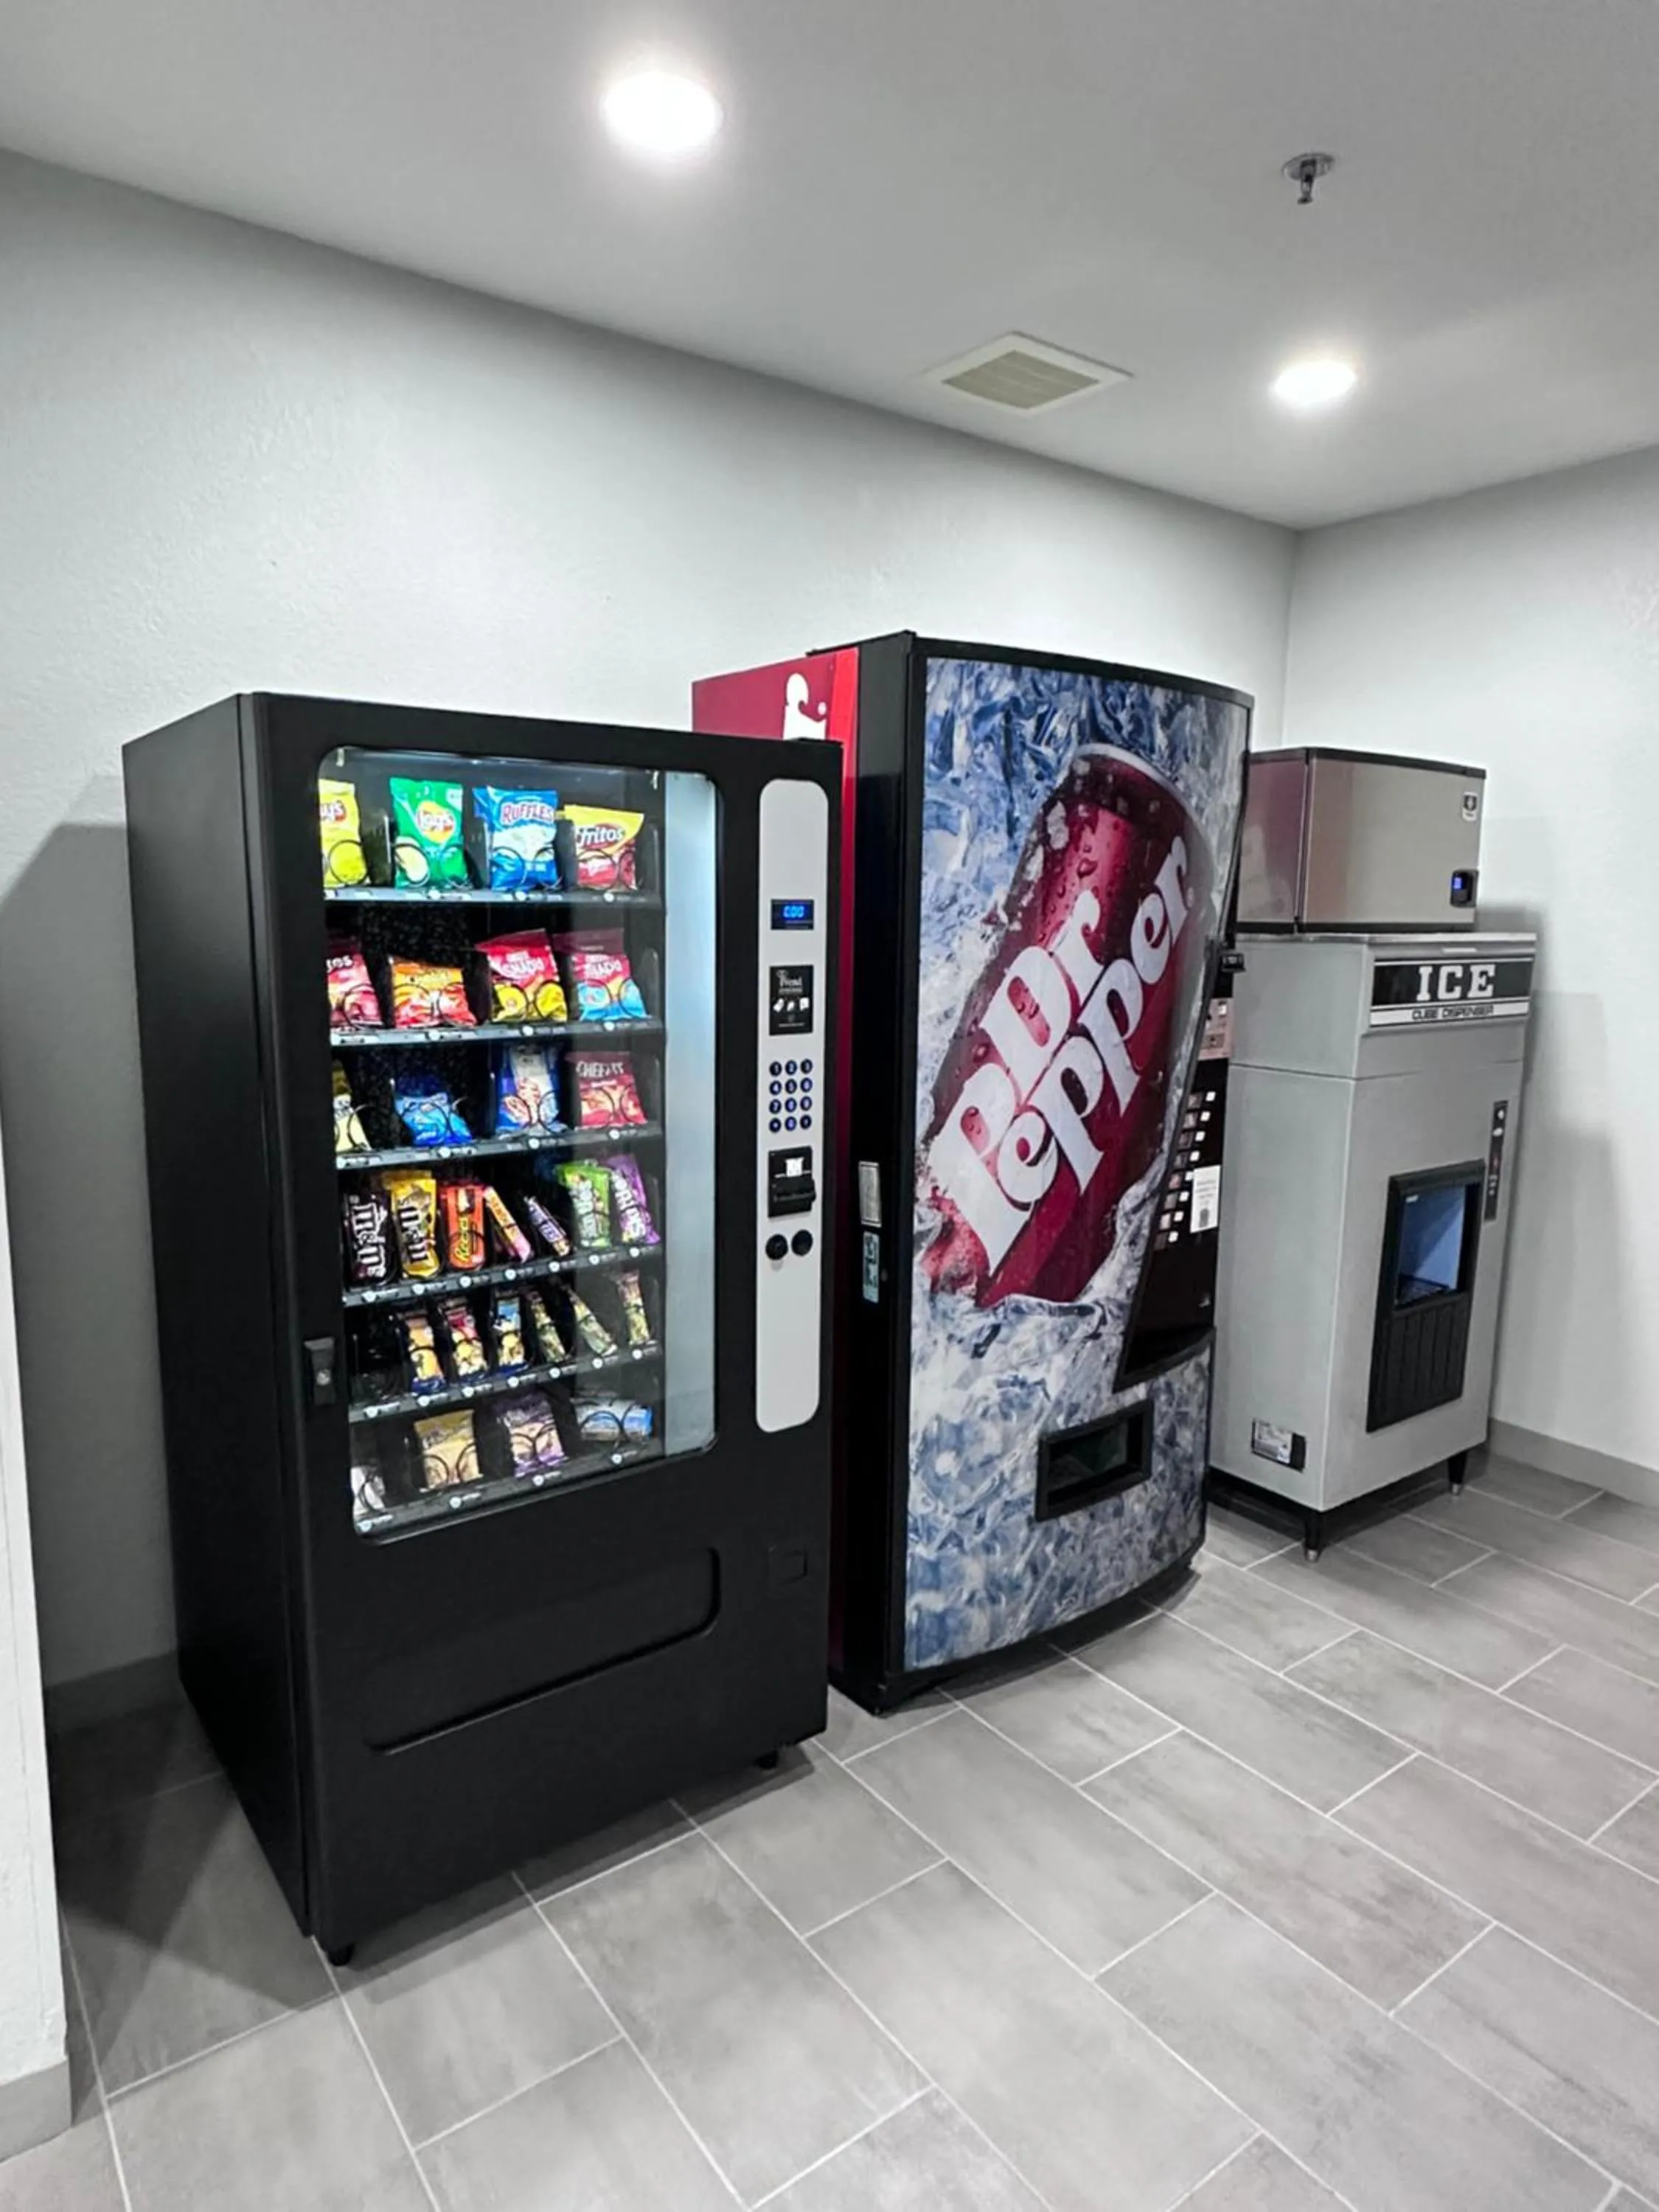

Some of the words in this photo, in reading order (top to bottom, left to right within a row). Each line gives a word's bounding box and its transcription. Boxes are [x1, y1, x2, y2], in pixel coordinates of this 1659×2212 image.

[500, 801, 557, 826] RUFFLES
[577, 825, 626, 846] Fritos
[978, 889, 1105, 1102] Dr
[1416, 964, 1496, 1001] ICE
[1411, 1007, 1438, 1021] CUBE
[929, 835, 1190, 1279] Pepper
